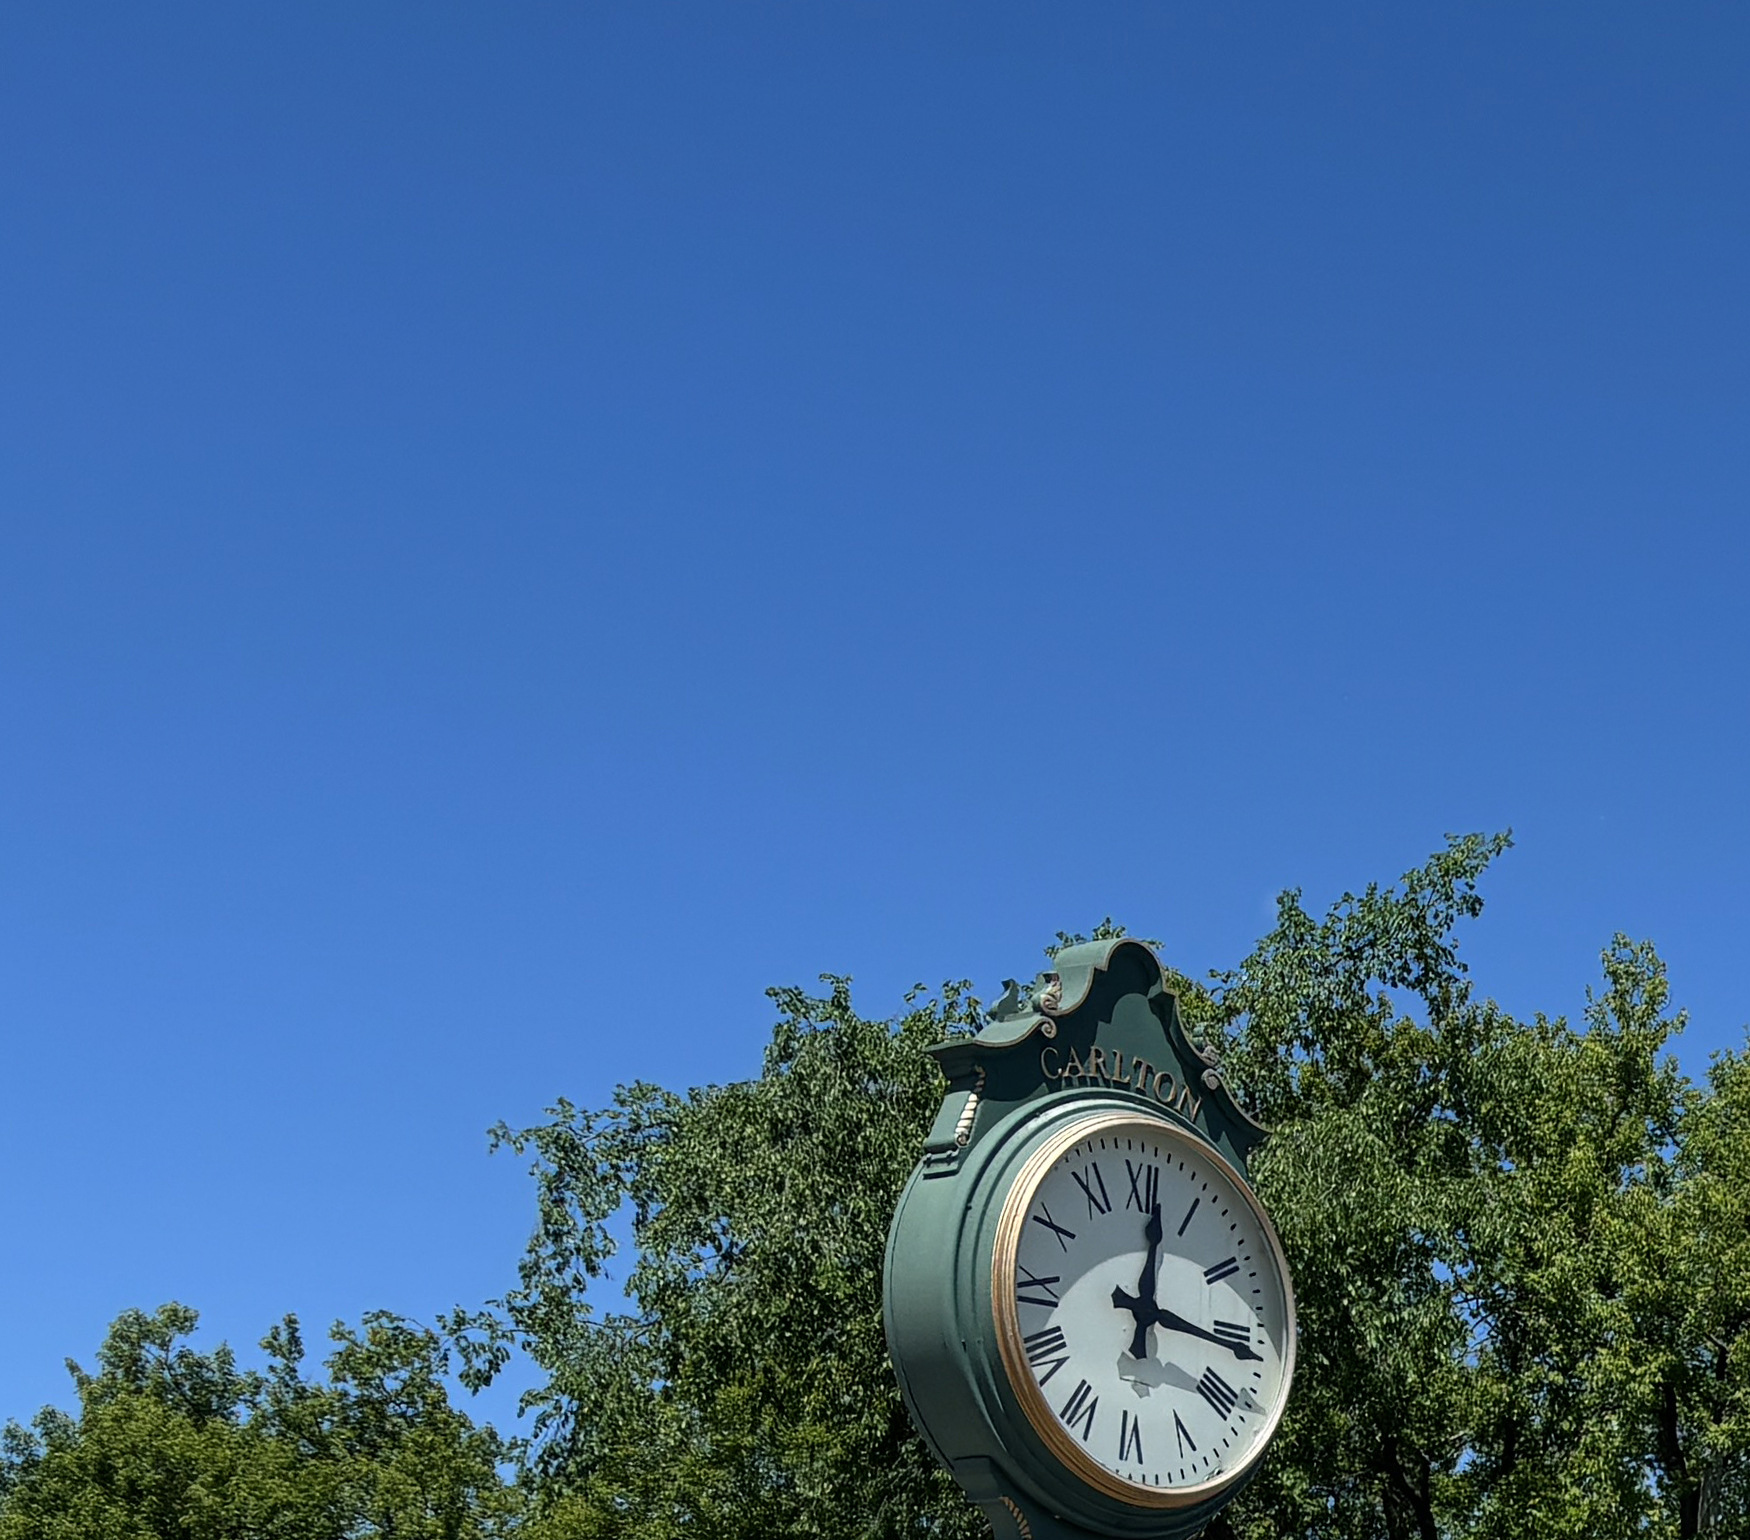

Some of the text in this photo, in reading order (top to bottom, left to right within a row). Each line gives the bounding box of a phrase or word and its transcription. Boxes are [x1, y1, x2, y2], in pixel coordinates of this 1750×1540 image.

[1041, 1045, 1202, 1123] CARLTON
[1071, 1161, 1112, 1221] XI
[1125, 1159, 1159, 1214] XII
[1032, 1201, 1077, 1253] X
[1017, 1265, 1061, 1308] IX
[1023, 1325, 1070, 1387] VIII
[1059, 1379, 1099, 1442] VII
[1196, 1366, 1239, 1421] IIII
[1119, 1409, 1143, 1465] VI
[1172, 1409, 1197, 1459] V
